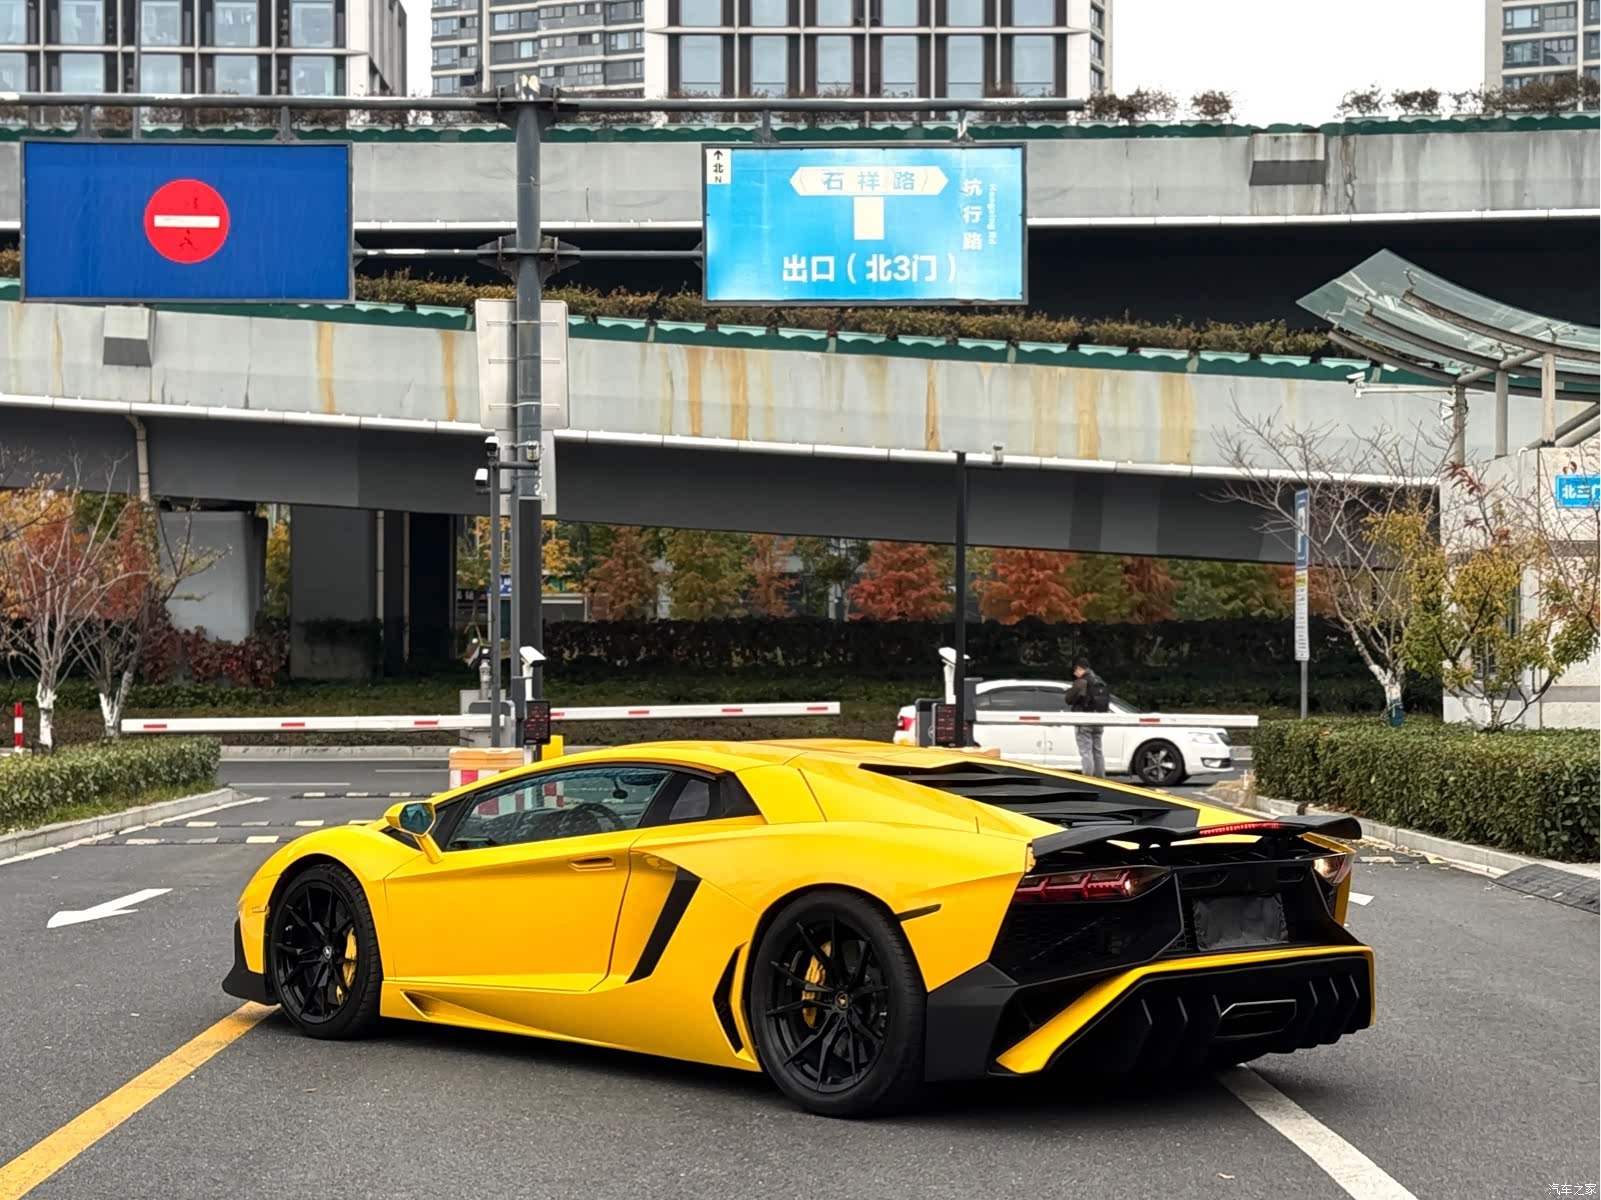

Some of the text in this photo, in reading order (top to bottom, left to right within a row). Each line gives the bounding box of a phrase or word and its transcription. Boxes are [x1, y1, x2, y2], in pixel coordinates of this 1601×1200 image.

[713, 163, 724, 174] 北
[714, 175, 722, 183] N
[823, 171, 916, 192] 石祥路
